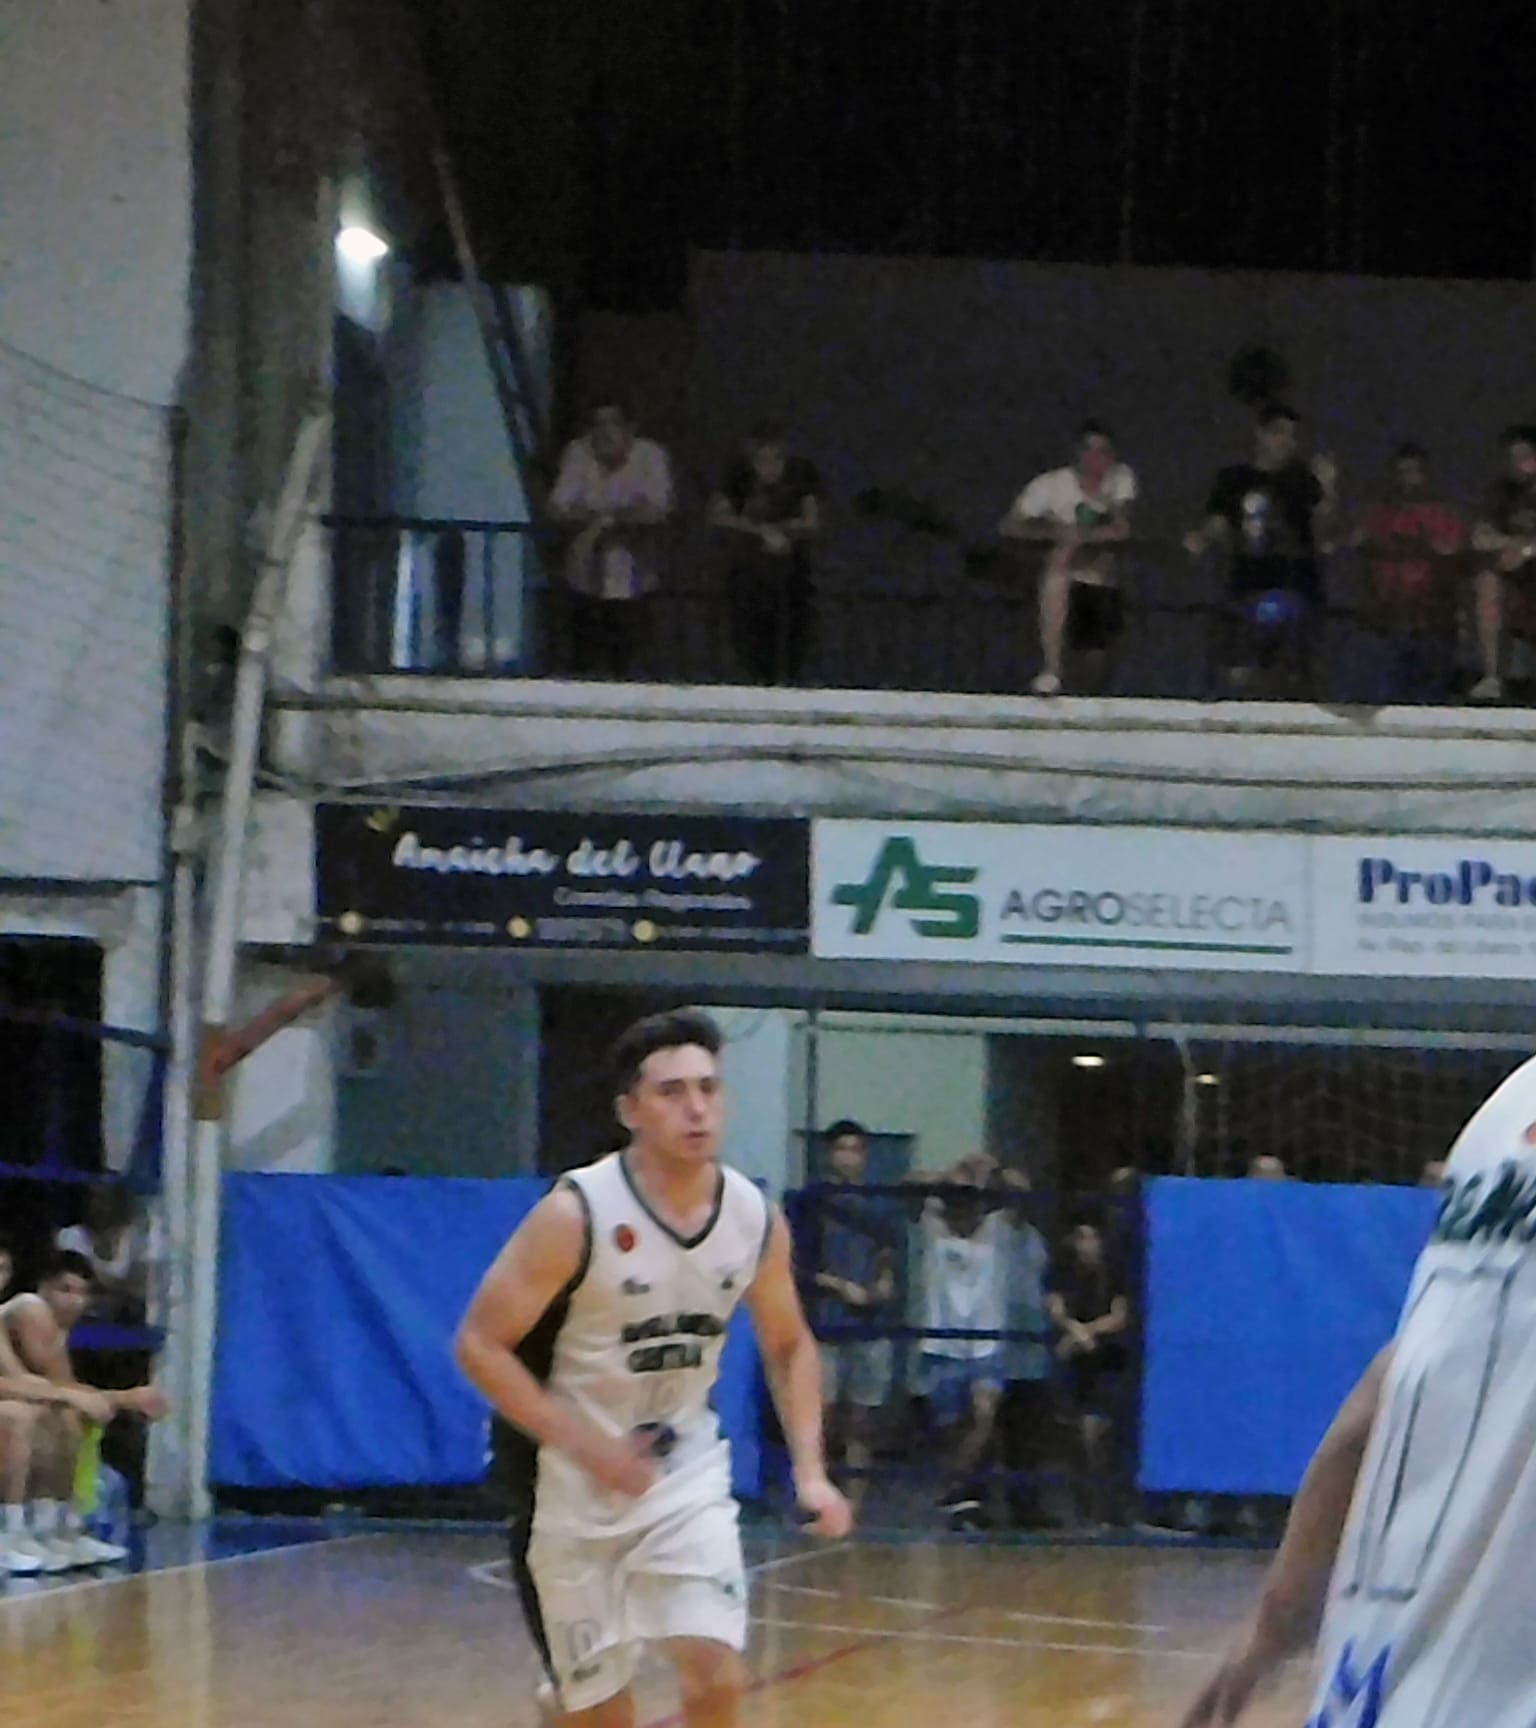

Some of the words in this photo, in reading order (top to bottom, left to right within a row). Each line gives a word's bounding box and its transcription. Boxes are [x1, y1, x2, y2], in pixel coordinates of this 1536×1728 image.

[565, 837, 641, 877] del
[830, 835, 981, 939] AS
[1000, 888, 1292, 934] AGROSELECTA
